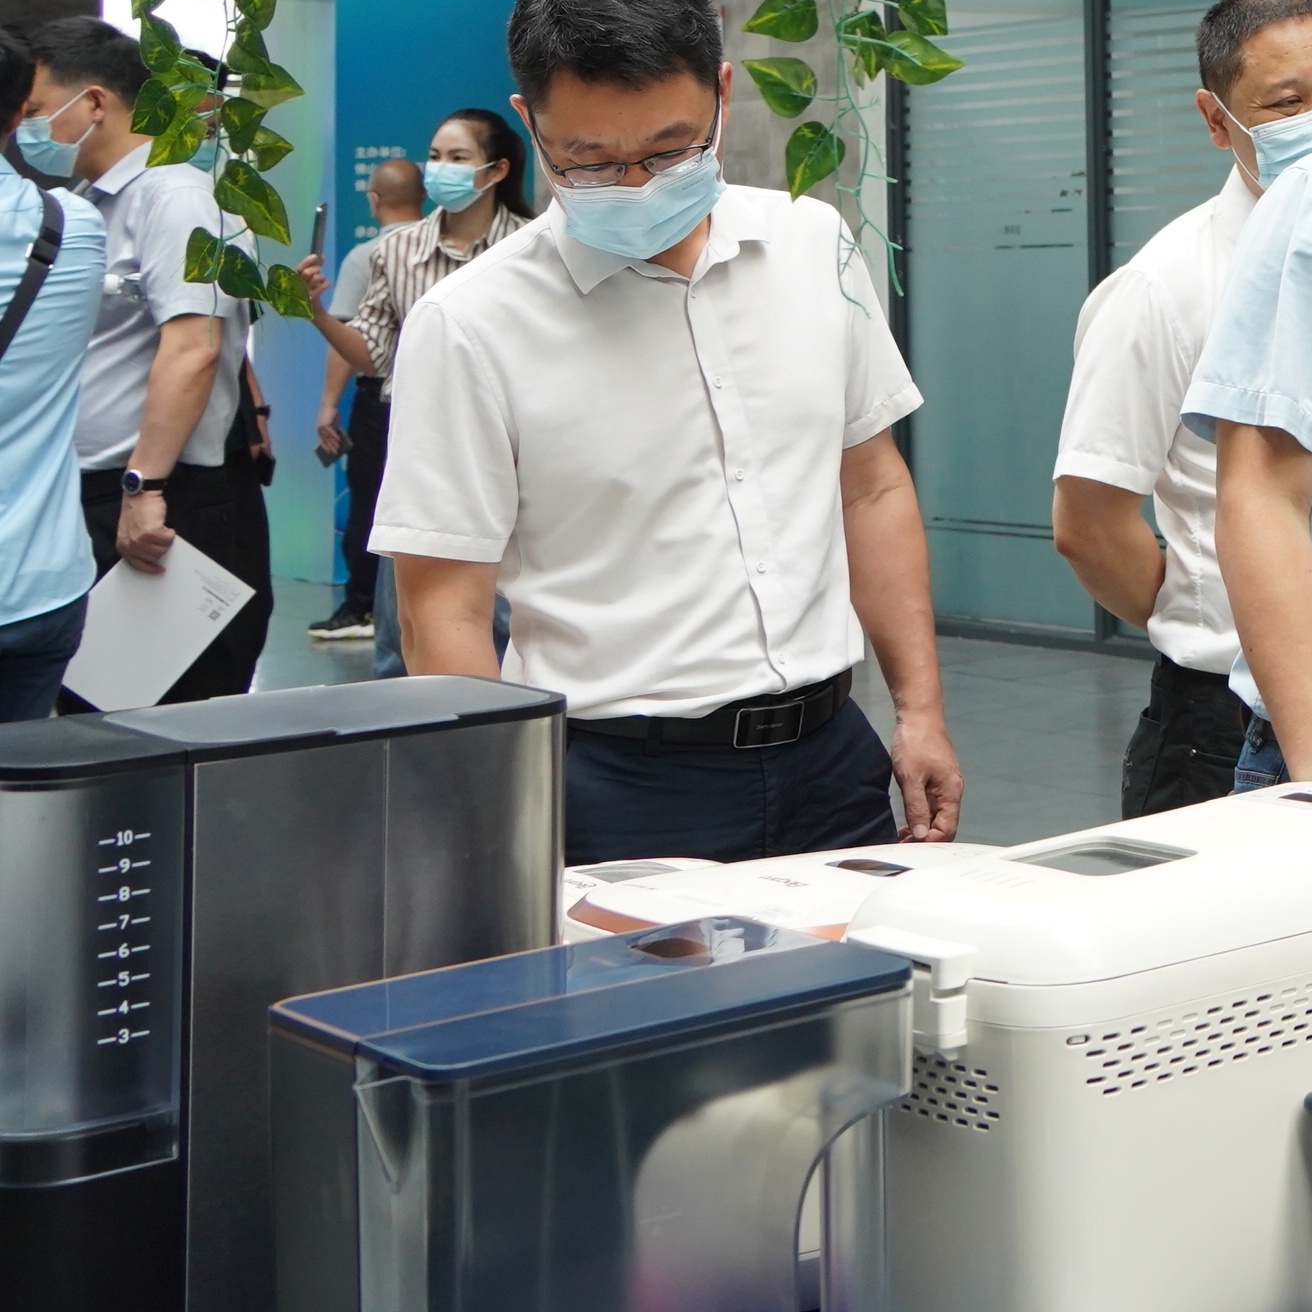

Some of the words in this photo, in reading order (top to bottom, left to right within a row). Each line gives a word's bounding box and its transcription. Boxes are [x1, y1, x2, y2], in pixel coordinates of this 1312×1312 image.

[117, 830, 133, 846] 10
[119, 858, 131, 873] 9
[118, 886, 130, 902] 8
[119, 914, 130, 930] 7
[118, 943, 130, 958] 6
[118, 971, 130, 987] 5
[118, 1000, 129, 1015] 4
[118, 1028, 130, 1044] 3
